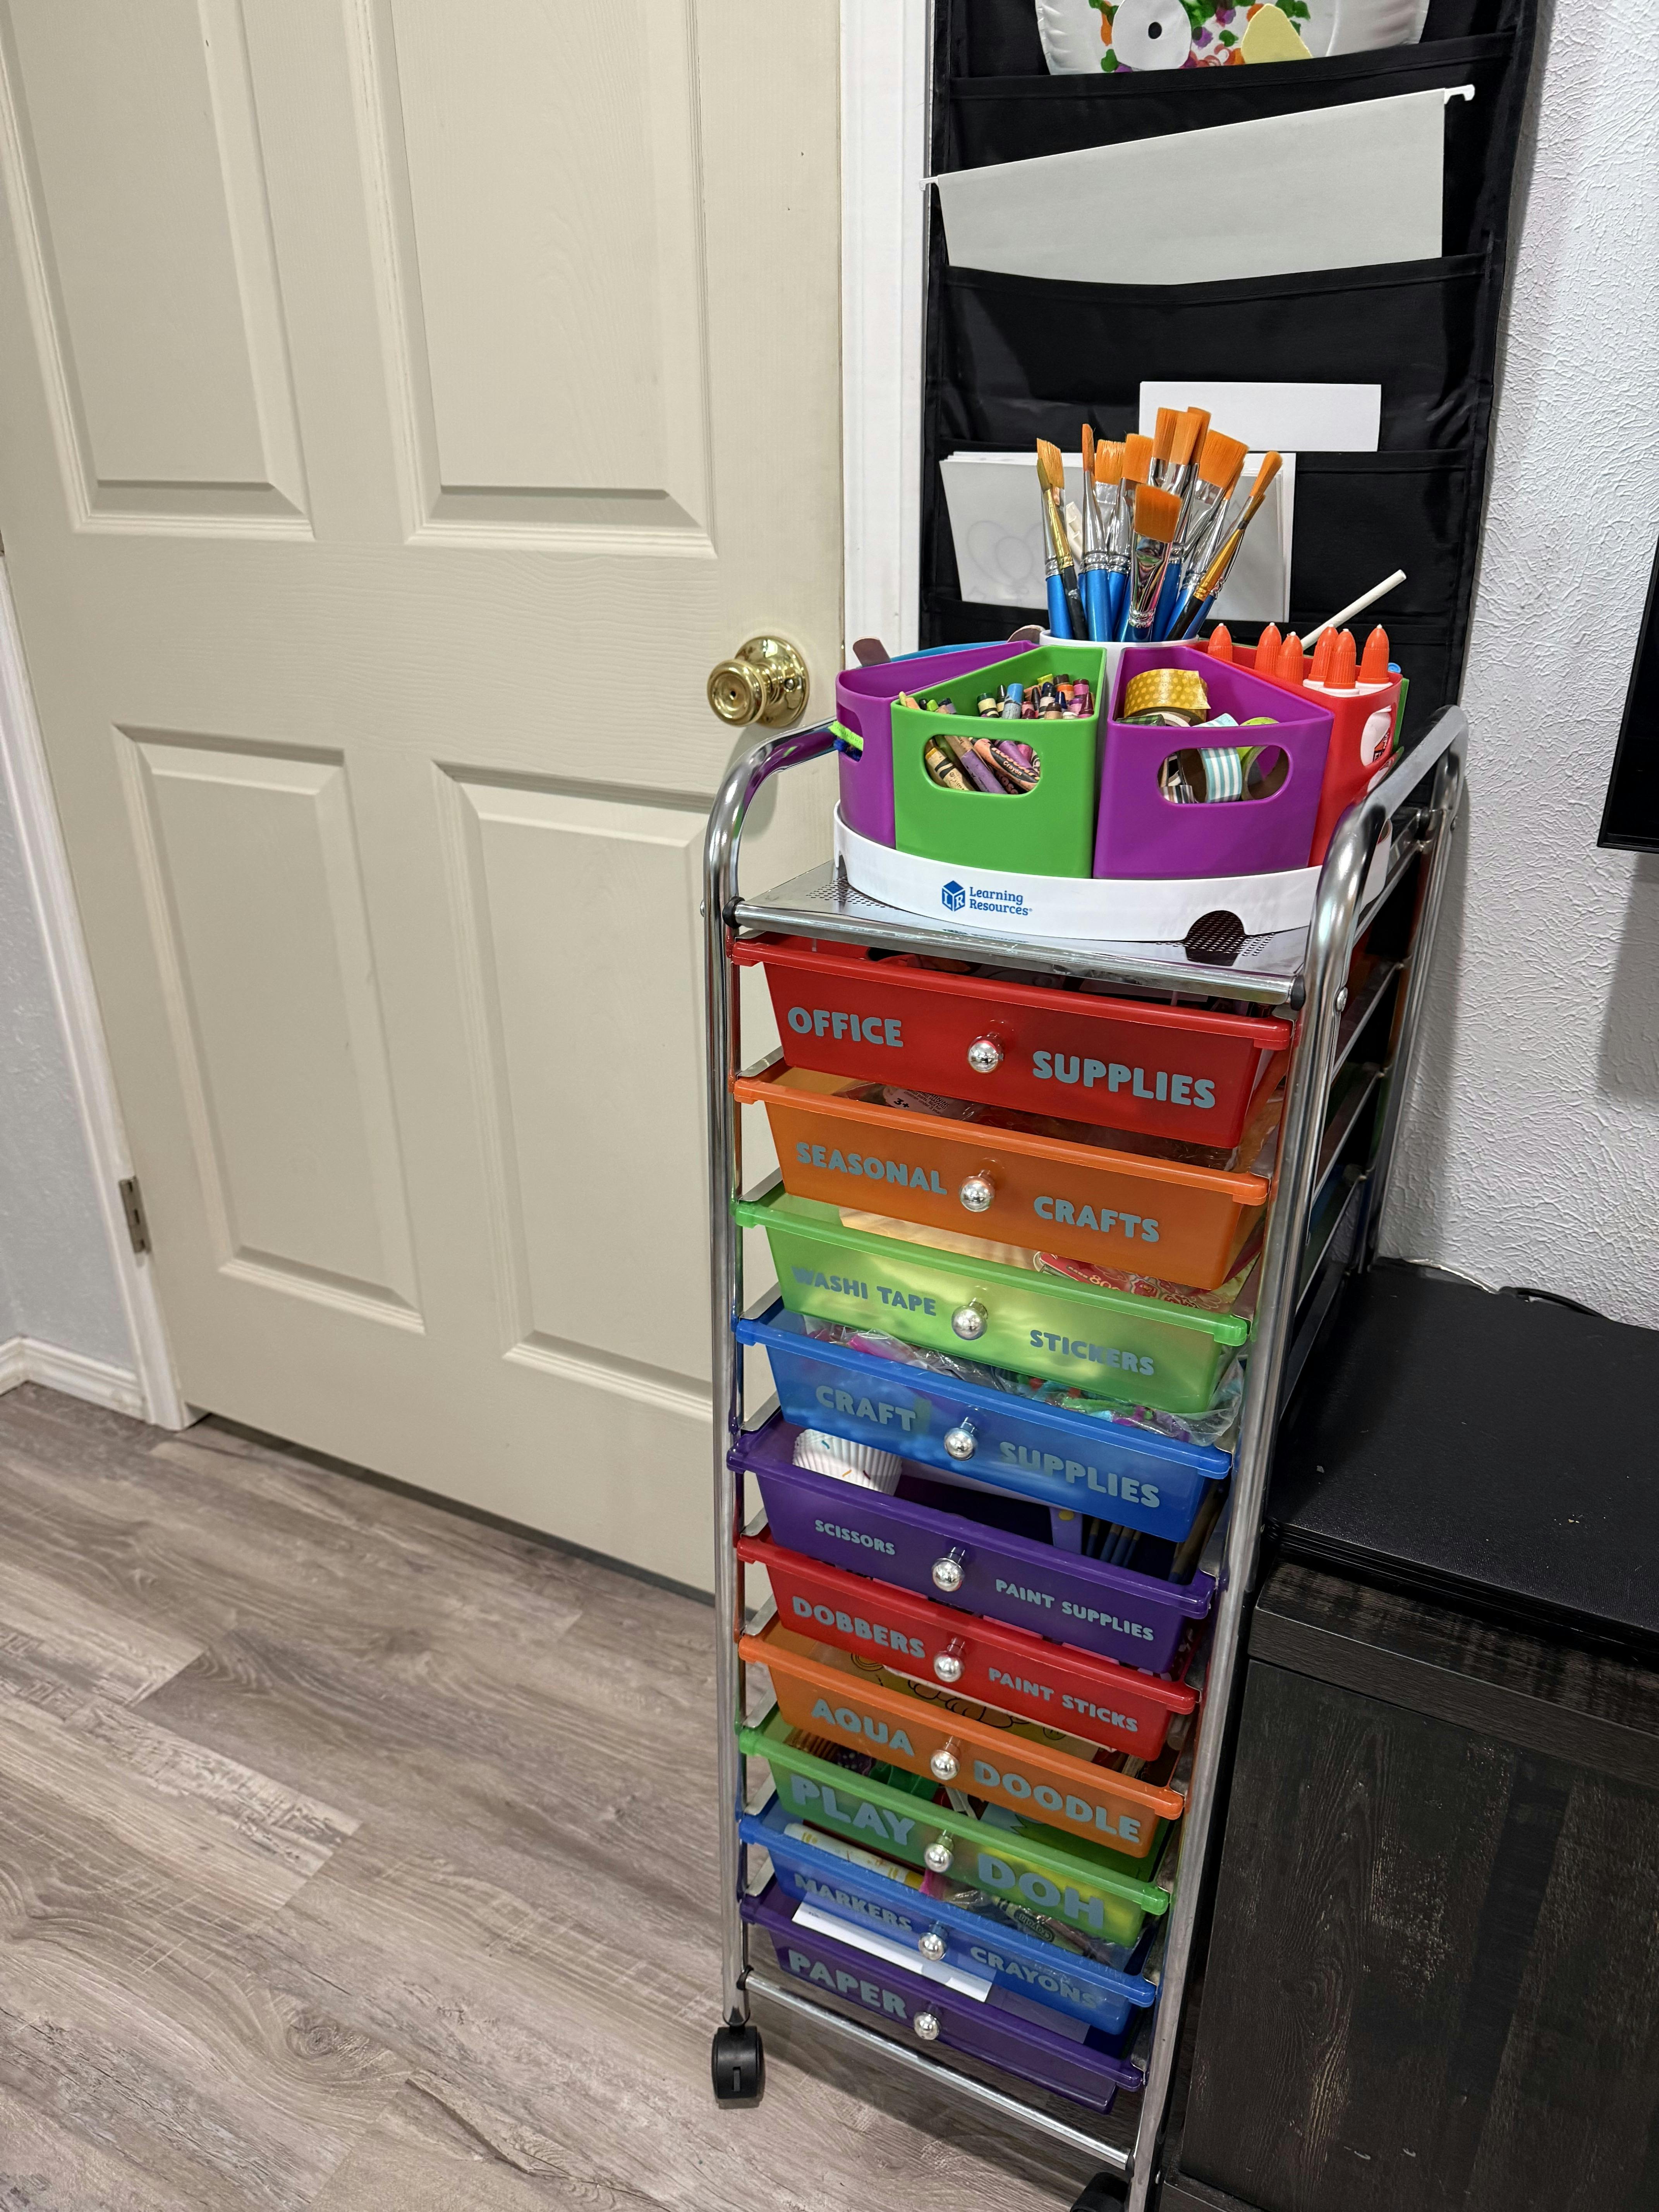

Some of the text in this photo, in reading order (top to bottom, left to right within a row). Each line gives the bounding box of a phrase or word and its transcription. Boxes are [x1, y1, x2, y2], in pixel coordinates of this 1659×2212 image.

[1003, 761, 1022, 775] Crayon
[970, 887, 1023, 905] Learning
[788, 1007, 1216, 1109] OFFICE SUPPLIES
[893, 1098, 910, 1108] 3+
[796, 1142, 1159, 1241] SEASONAL CRAFTS
[793, 1266, 1154, 1376] WASHI TAPE STICKERS
[816, 1386, 1160, 1508] CRAFT SUPPLIES
[815, 1520, 1154, 1641] SCISSORS PAINT SUPPLIES
[793, 1597, 1138, 1732] DOBBERS PAINT STICKS
[812, 1700, 1141, 1843] AQUA DOODLE
[790, 1776, 1104, 1928] PLAY DOH
[794, 1874, 1097, 2009] MARKERS CRAYONS
[1018, 1914, 1051, 1940] Crayola
[789, 1950, 907, 2018] PAPER
